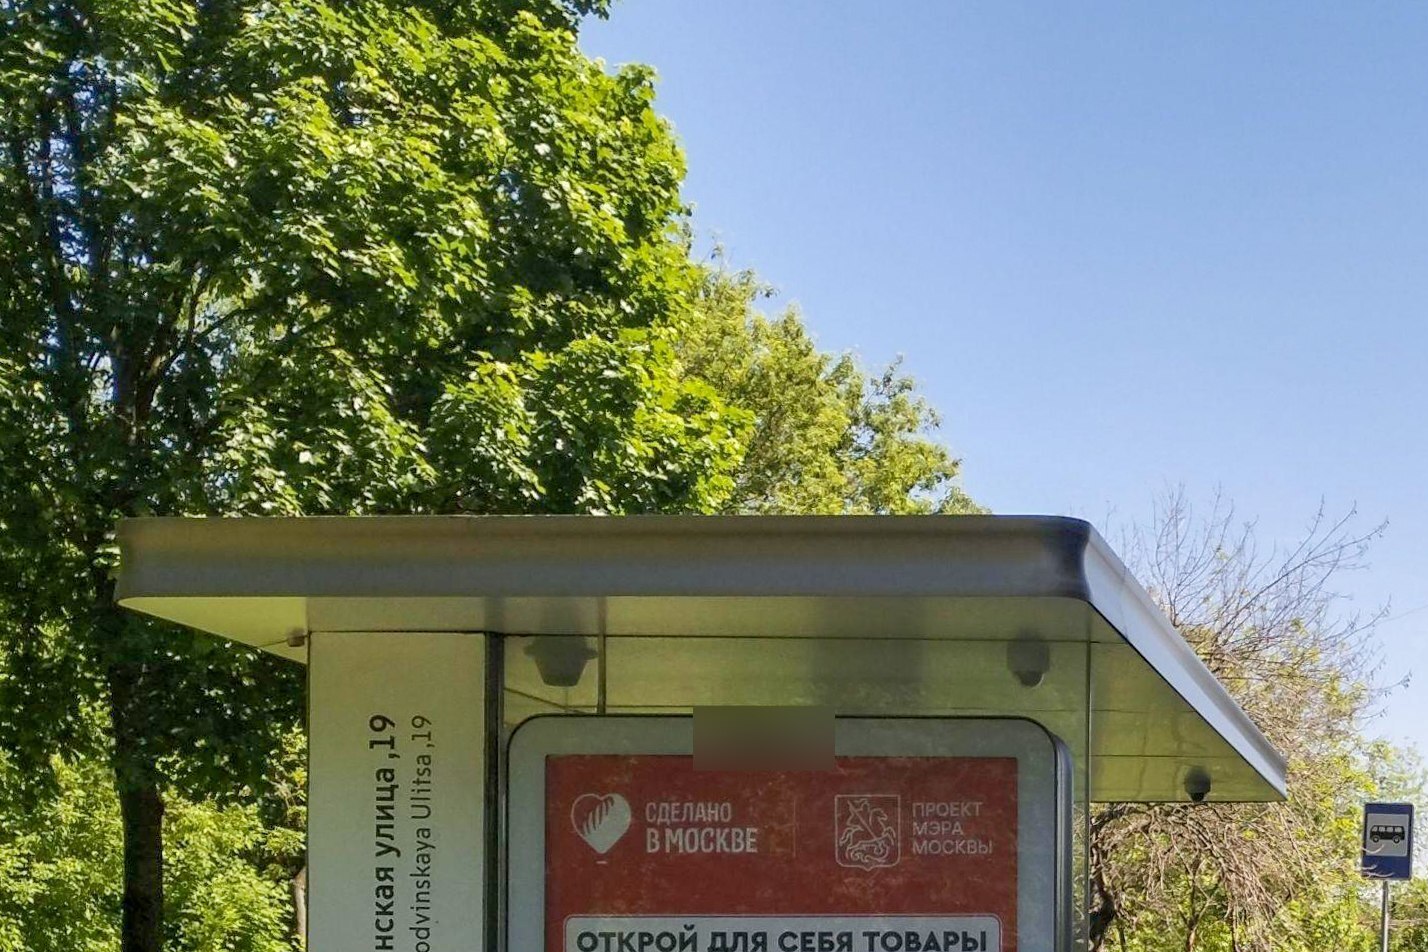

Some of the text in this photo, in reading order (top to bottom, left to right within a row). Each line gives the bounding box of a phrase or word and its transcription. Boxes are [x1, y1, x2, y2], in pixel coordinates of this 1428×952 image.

[374, 767, 401, 859] улица
[645, 802, 732, 824] СДЕЛАНО
[912, 802, 983, 817] ПРОЕКТ
[912, 821, 964, 836] МЭРА
[646, 827, 759, 854] В МОСКВЕ
[912, 839, 993, 855] МОСКВЫ
